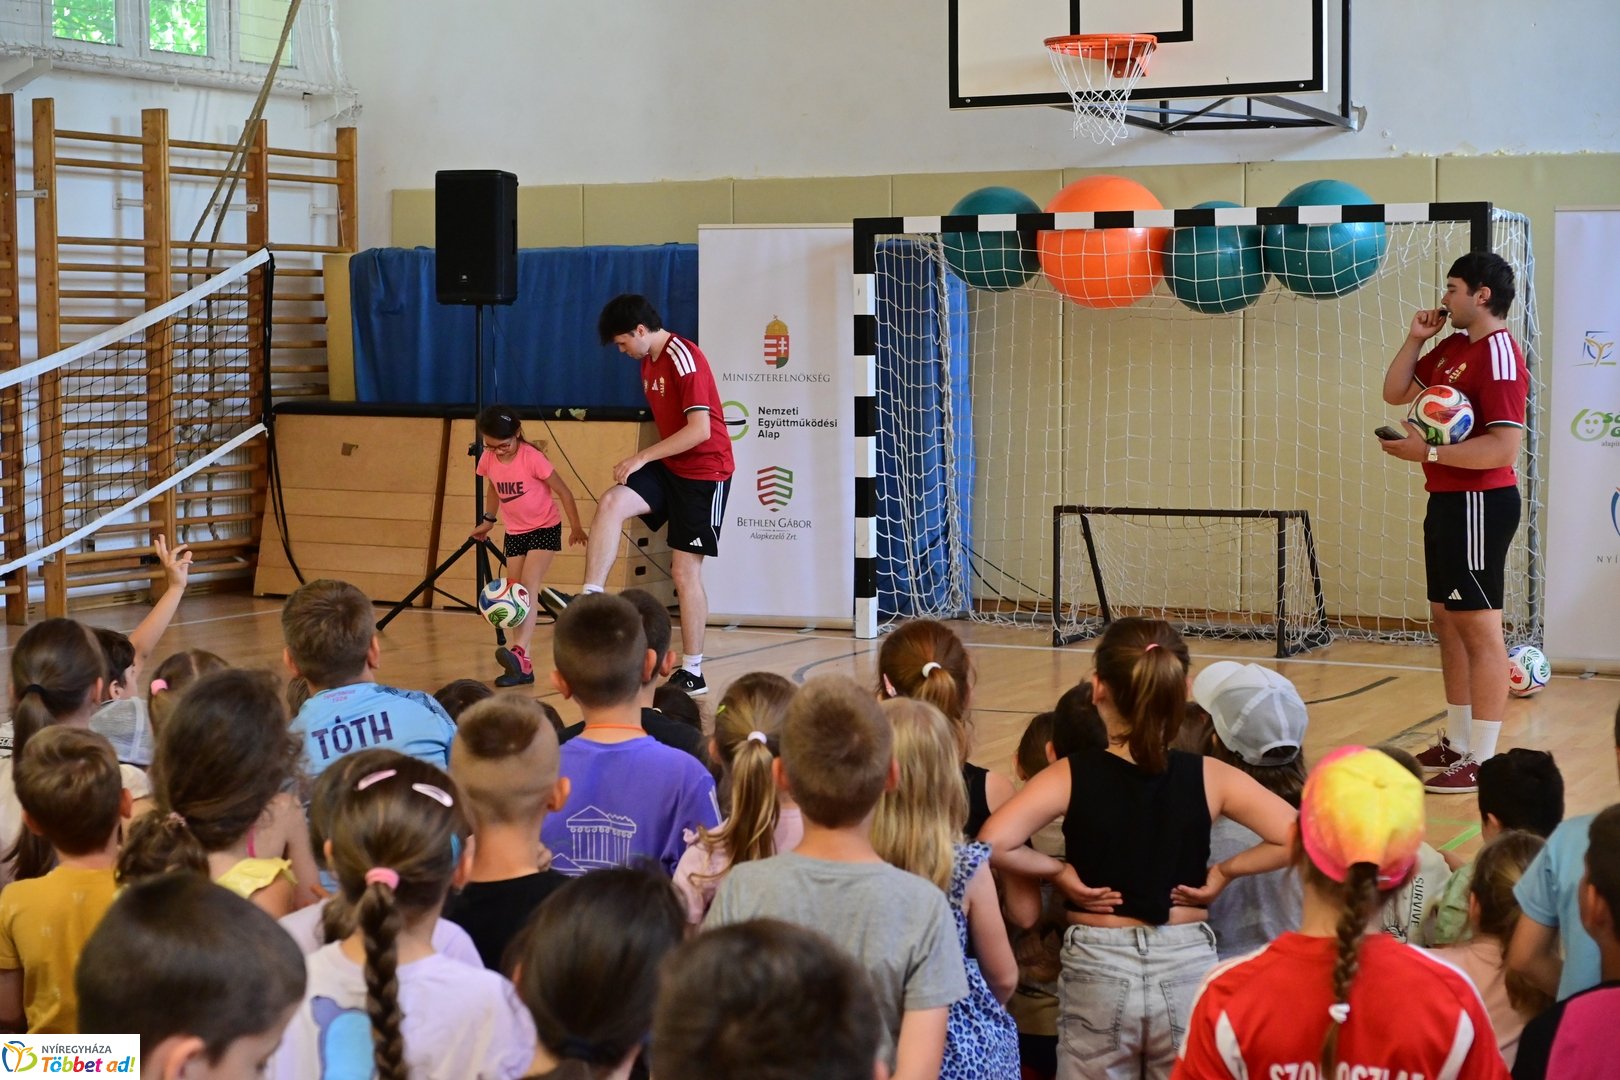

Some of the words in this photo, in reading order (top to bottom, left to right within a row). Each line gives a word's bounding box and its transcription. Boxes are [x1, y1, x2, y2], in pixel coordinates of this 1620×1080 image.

[722, 372, 831, 383] MINISZTERELNÖKSÉG
[758, 406, 799, 416] Nemzeti
[758, 418, 838, 429] Együttműködési
[758, 430, 780, 440] Alap
[496, 481, 524, 495] NIKE
[737, 516, 776, 528] BETHLEN
[778, 517, 812, 529] GÁBOR
[311, 711, 394, 760] TÓTH
